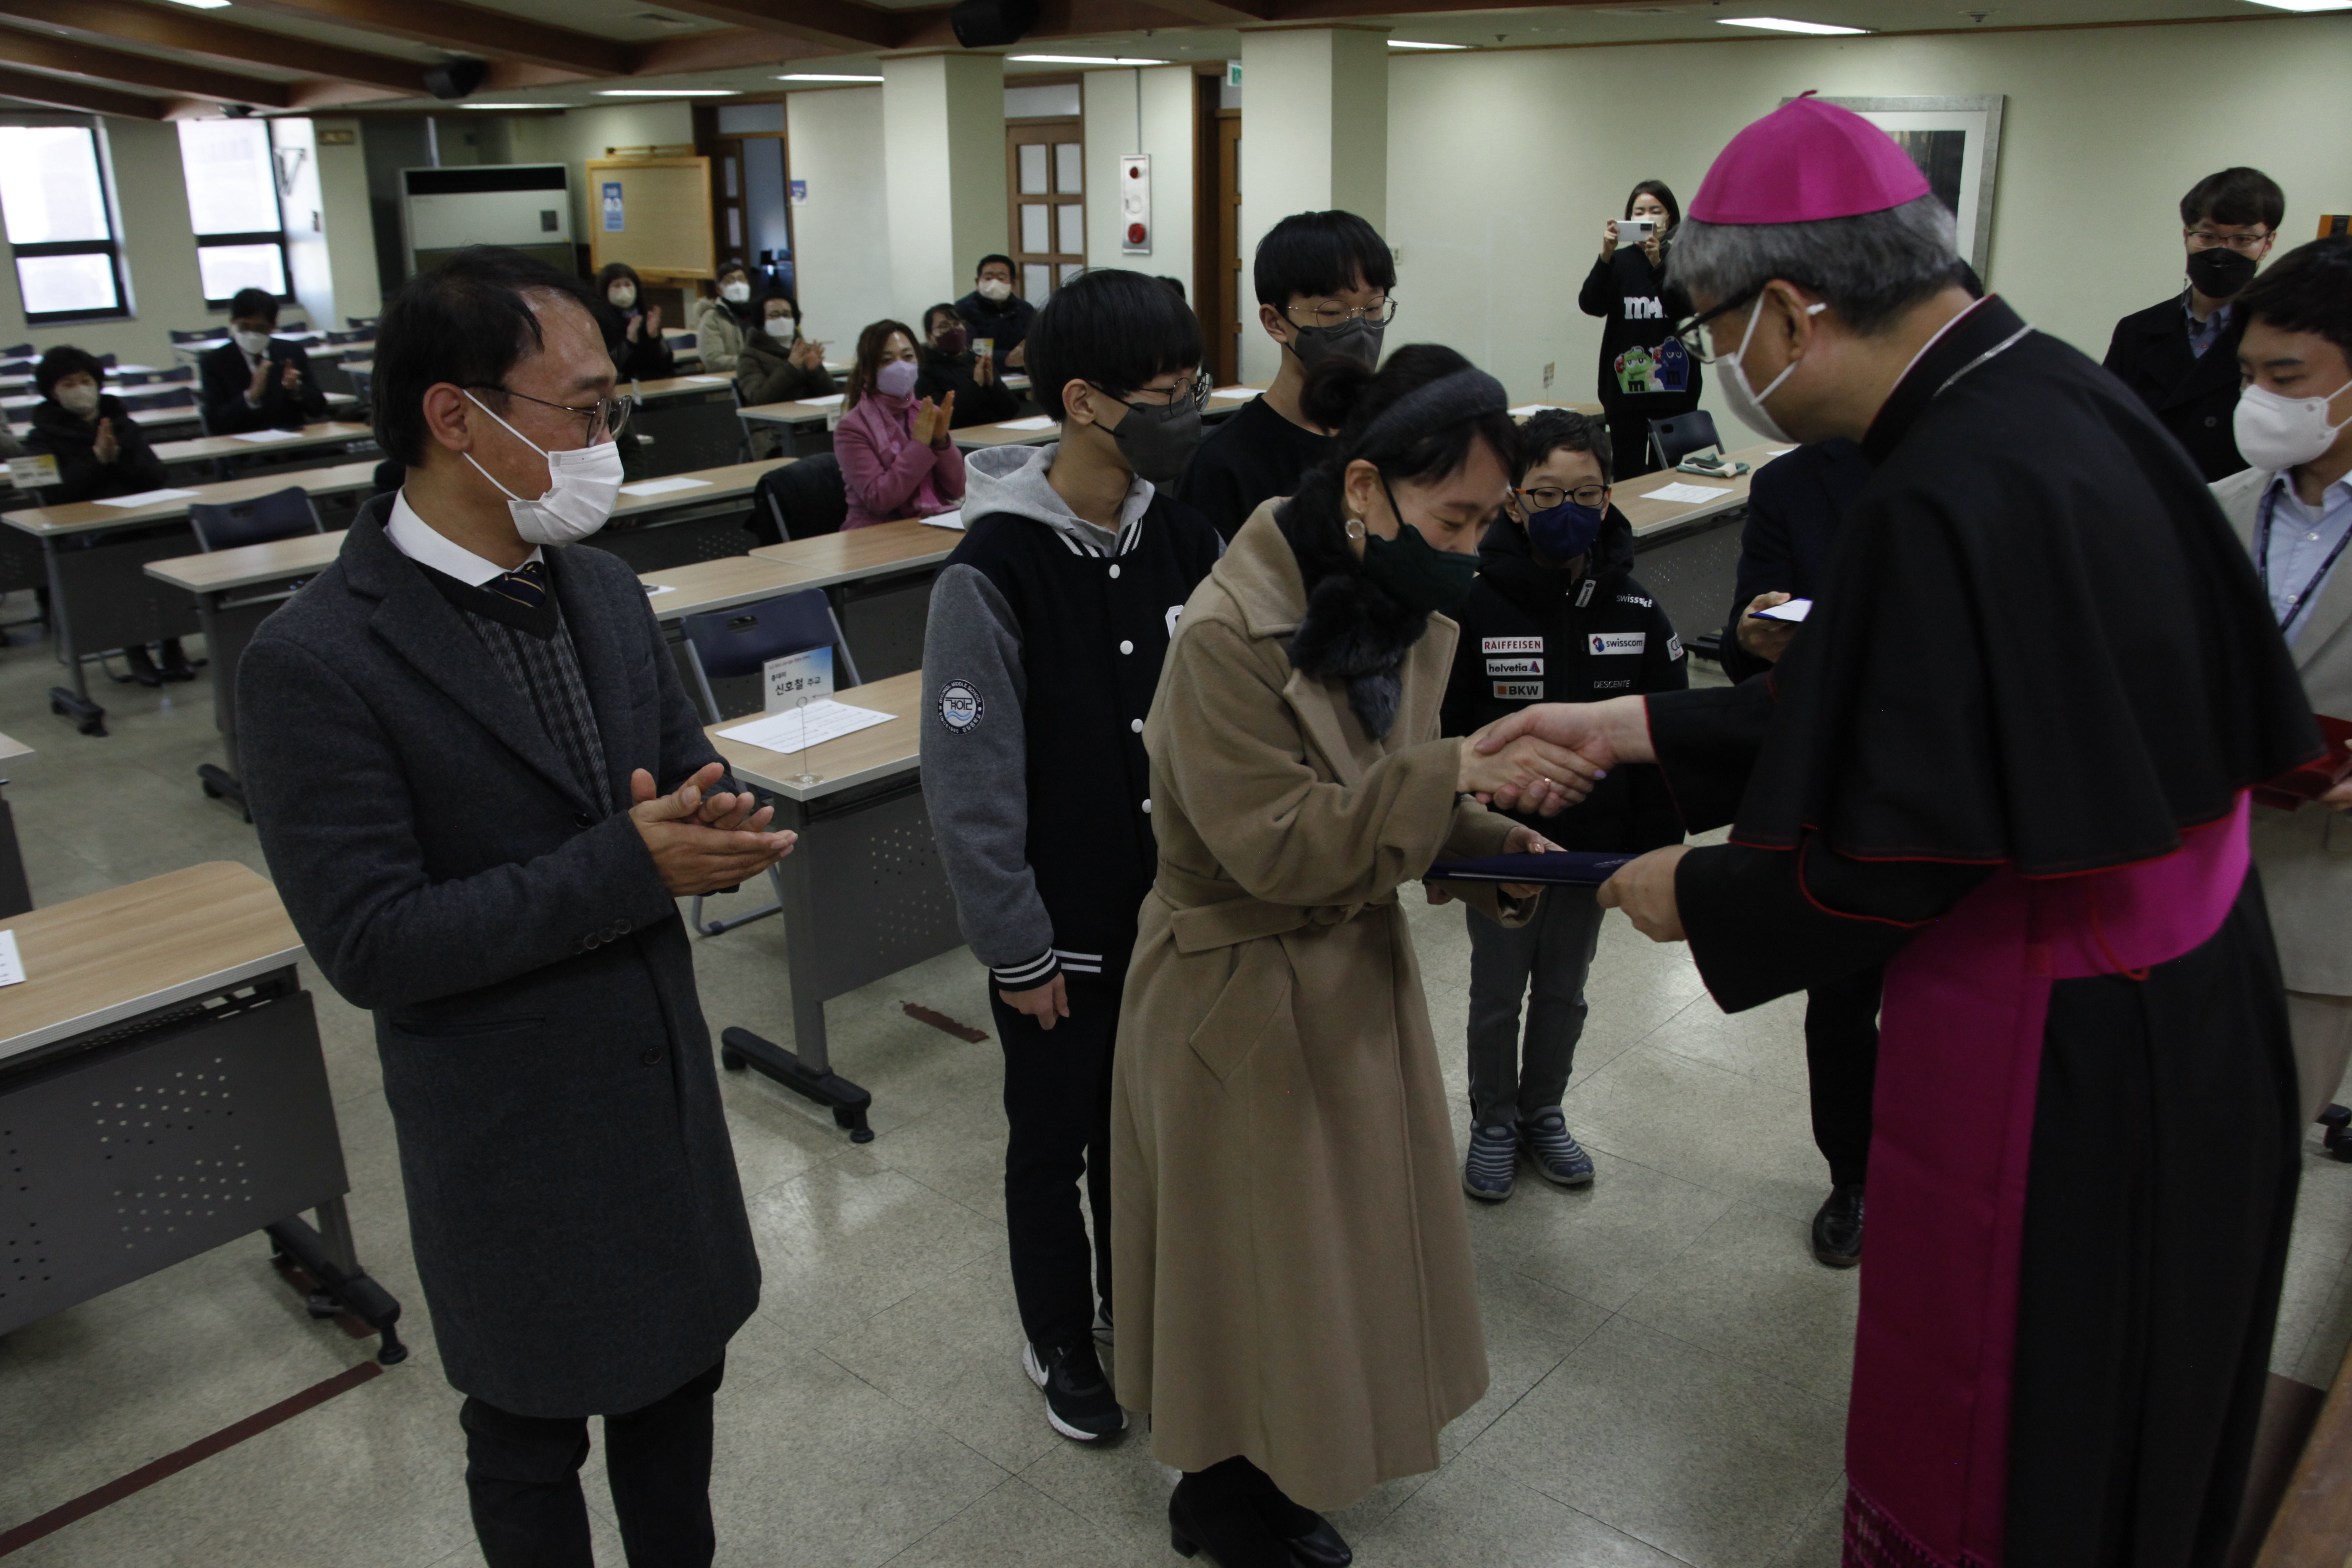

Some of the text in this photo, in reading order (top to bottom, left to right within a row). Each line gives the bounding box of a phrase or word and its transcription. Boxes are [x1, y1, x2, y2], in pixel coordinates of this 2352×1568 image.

[1484, 641, 1541, 650] RAIFFEISEN
[1606, 638, 1643, 647] swisscom
[1489, 663, 1528, 672] helvetia
[775, 678, 803, 696] 신호철
[807, 676, 821, 686] 주교
[1594, 680, 1630, 689] DESCENTE
[967, 686, 982, 704] SCHOOL
[1509, 686, 1539, 695] BKW
